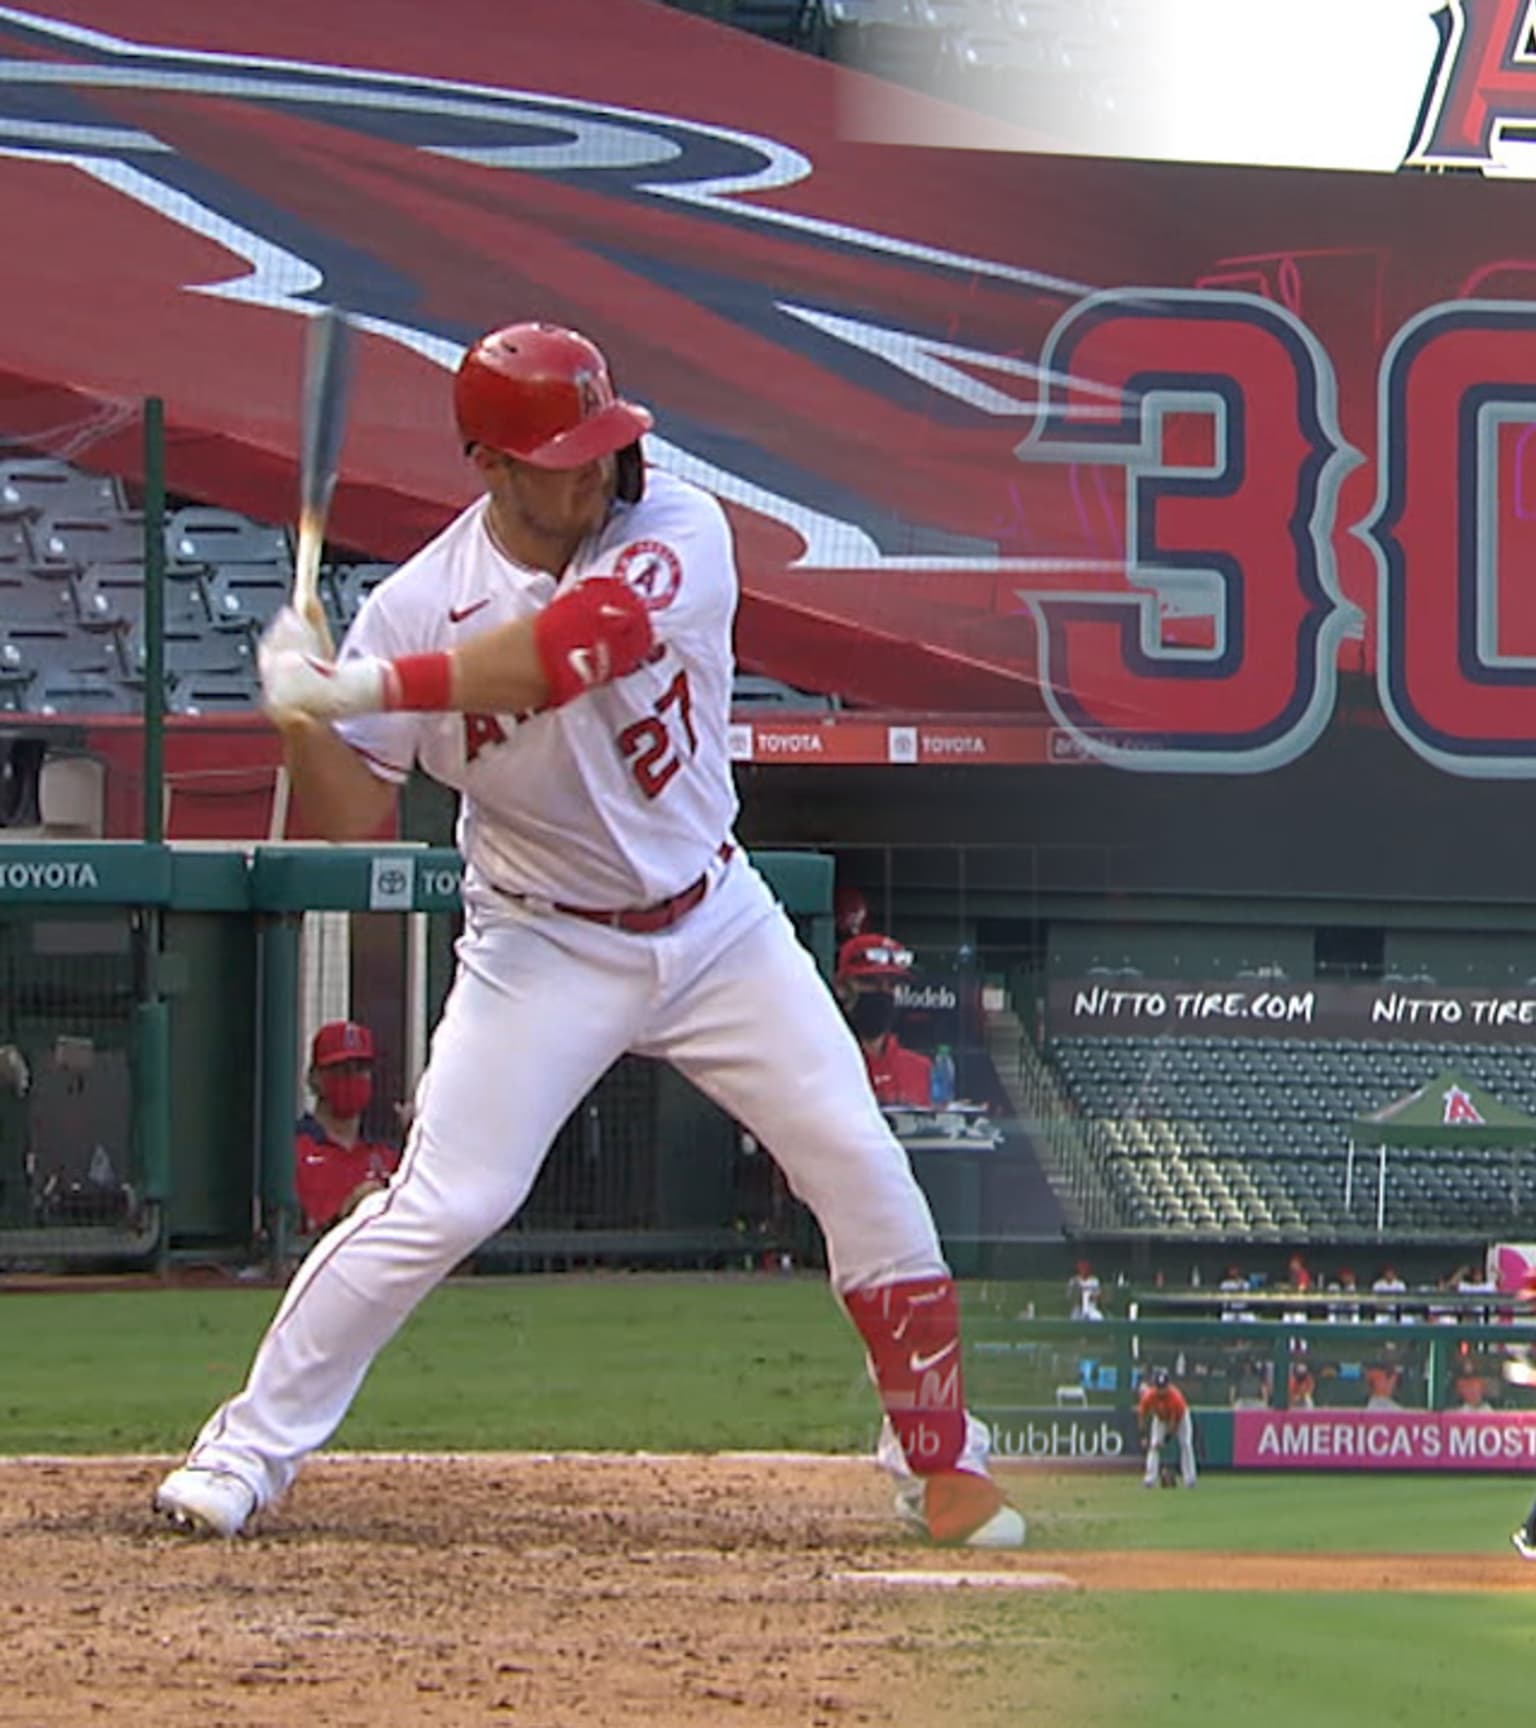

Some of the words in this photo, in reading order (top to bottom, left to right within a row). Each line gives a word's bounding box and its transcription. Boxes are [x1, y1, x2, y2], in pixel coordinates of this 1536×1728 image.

[617, 669, 697, 800] 27
[758, 734, 823, 752] TOYOTA
[921, 736, 985, 753] TOYOTA
[1074, 985, 1165, 1017] NITTO
[1175, 992, 1315, 1023] TIRE.COM
[1372, 992, 1462, 1025] NITTO
[1257, 1424, 1442, 1457] AMERICA'S
